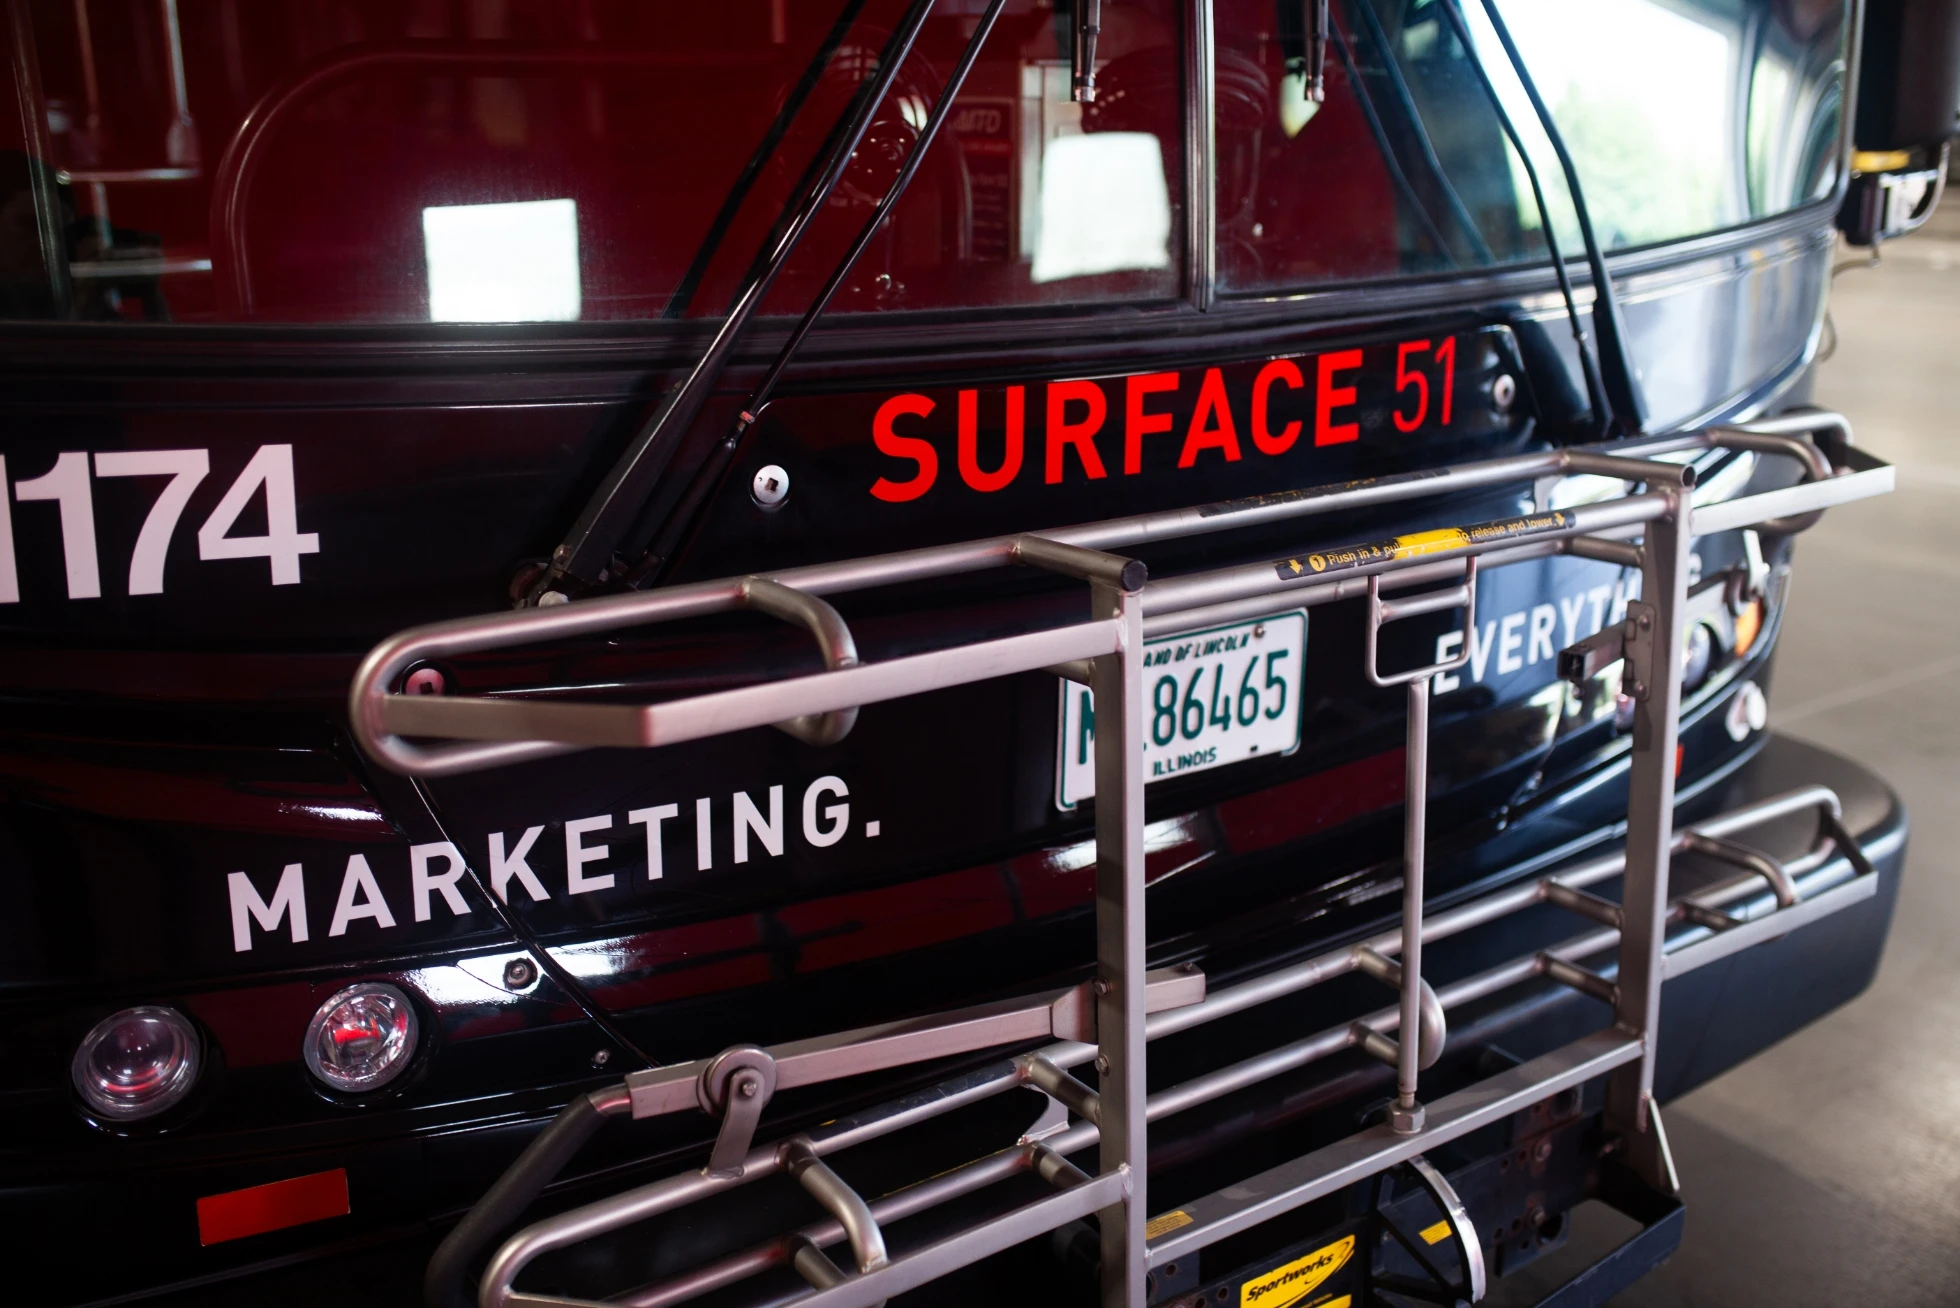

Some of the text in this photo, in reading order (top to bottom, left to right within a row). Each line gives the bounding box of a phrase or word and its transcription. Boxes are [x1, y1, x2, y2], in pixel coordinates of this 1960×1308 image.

[870, 336, 1455, 503] SURFACE 51
[0, 444, 320, 603] 174
[1326, 551, 1357, 566] Push
[1357, 548, 1371, 560] in
[1371, 546, 1382, 557] &
[1471, 525, 1506, 539] release
[1507, 520, 1526, 532] and
[1143, 633, 1250, 669] AND OF LINCOLN
[1153, 747, 1218, 776] ILLINOIS
[228, 776, 880, 952] MARKETING.
[1246, 1252, 1334, 1301] Sportworks
